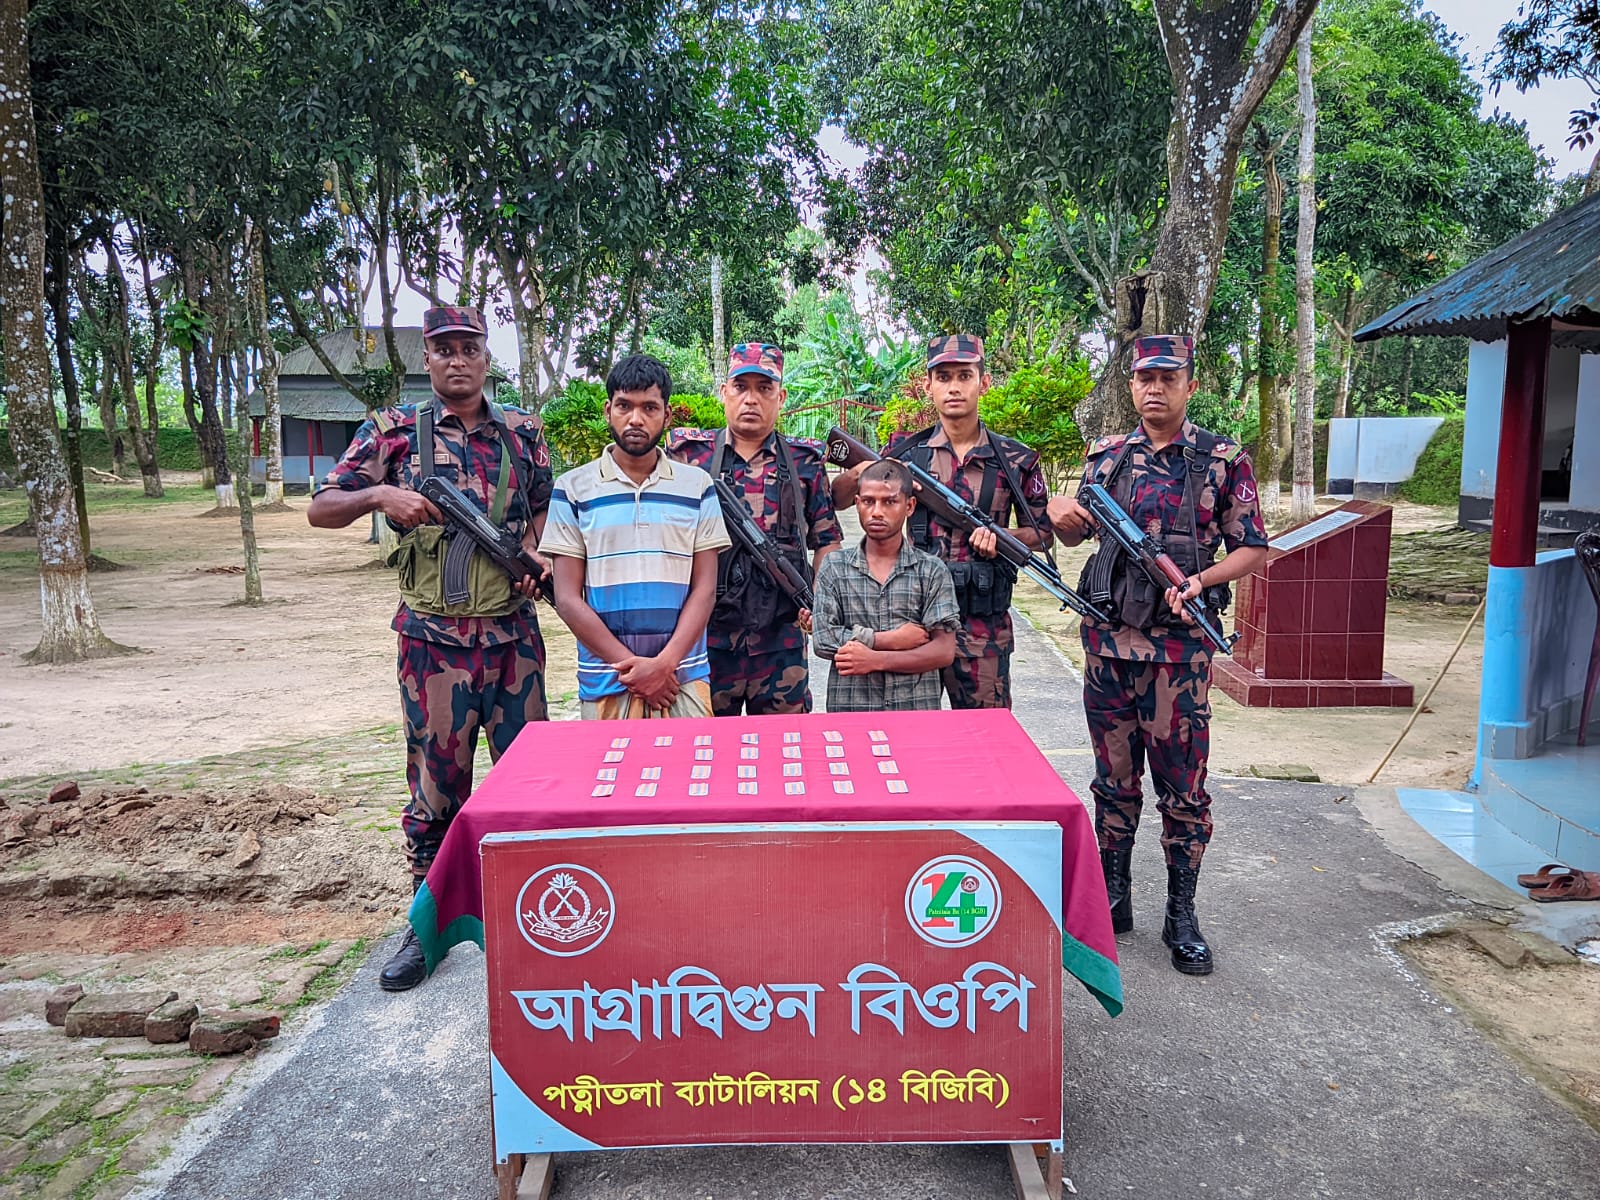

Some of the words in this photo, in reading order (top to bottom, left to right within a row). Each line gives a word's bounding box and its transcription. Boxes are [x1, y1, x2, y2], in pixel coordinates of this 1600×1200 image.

[511, 966, 824, 1041] আগ্রাদ্বিগুন
[839, 961, 1036, 1035] বিওপি
[542, 1074, 664, 1116] পত্নীতলা
[672, 1071, 820, 1107] ব্যাটালিয়ন
[832, 1074, 887, 1111] (১৪
[899, 1068, 1011, 1109] বিজিবি)
